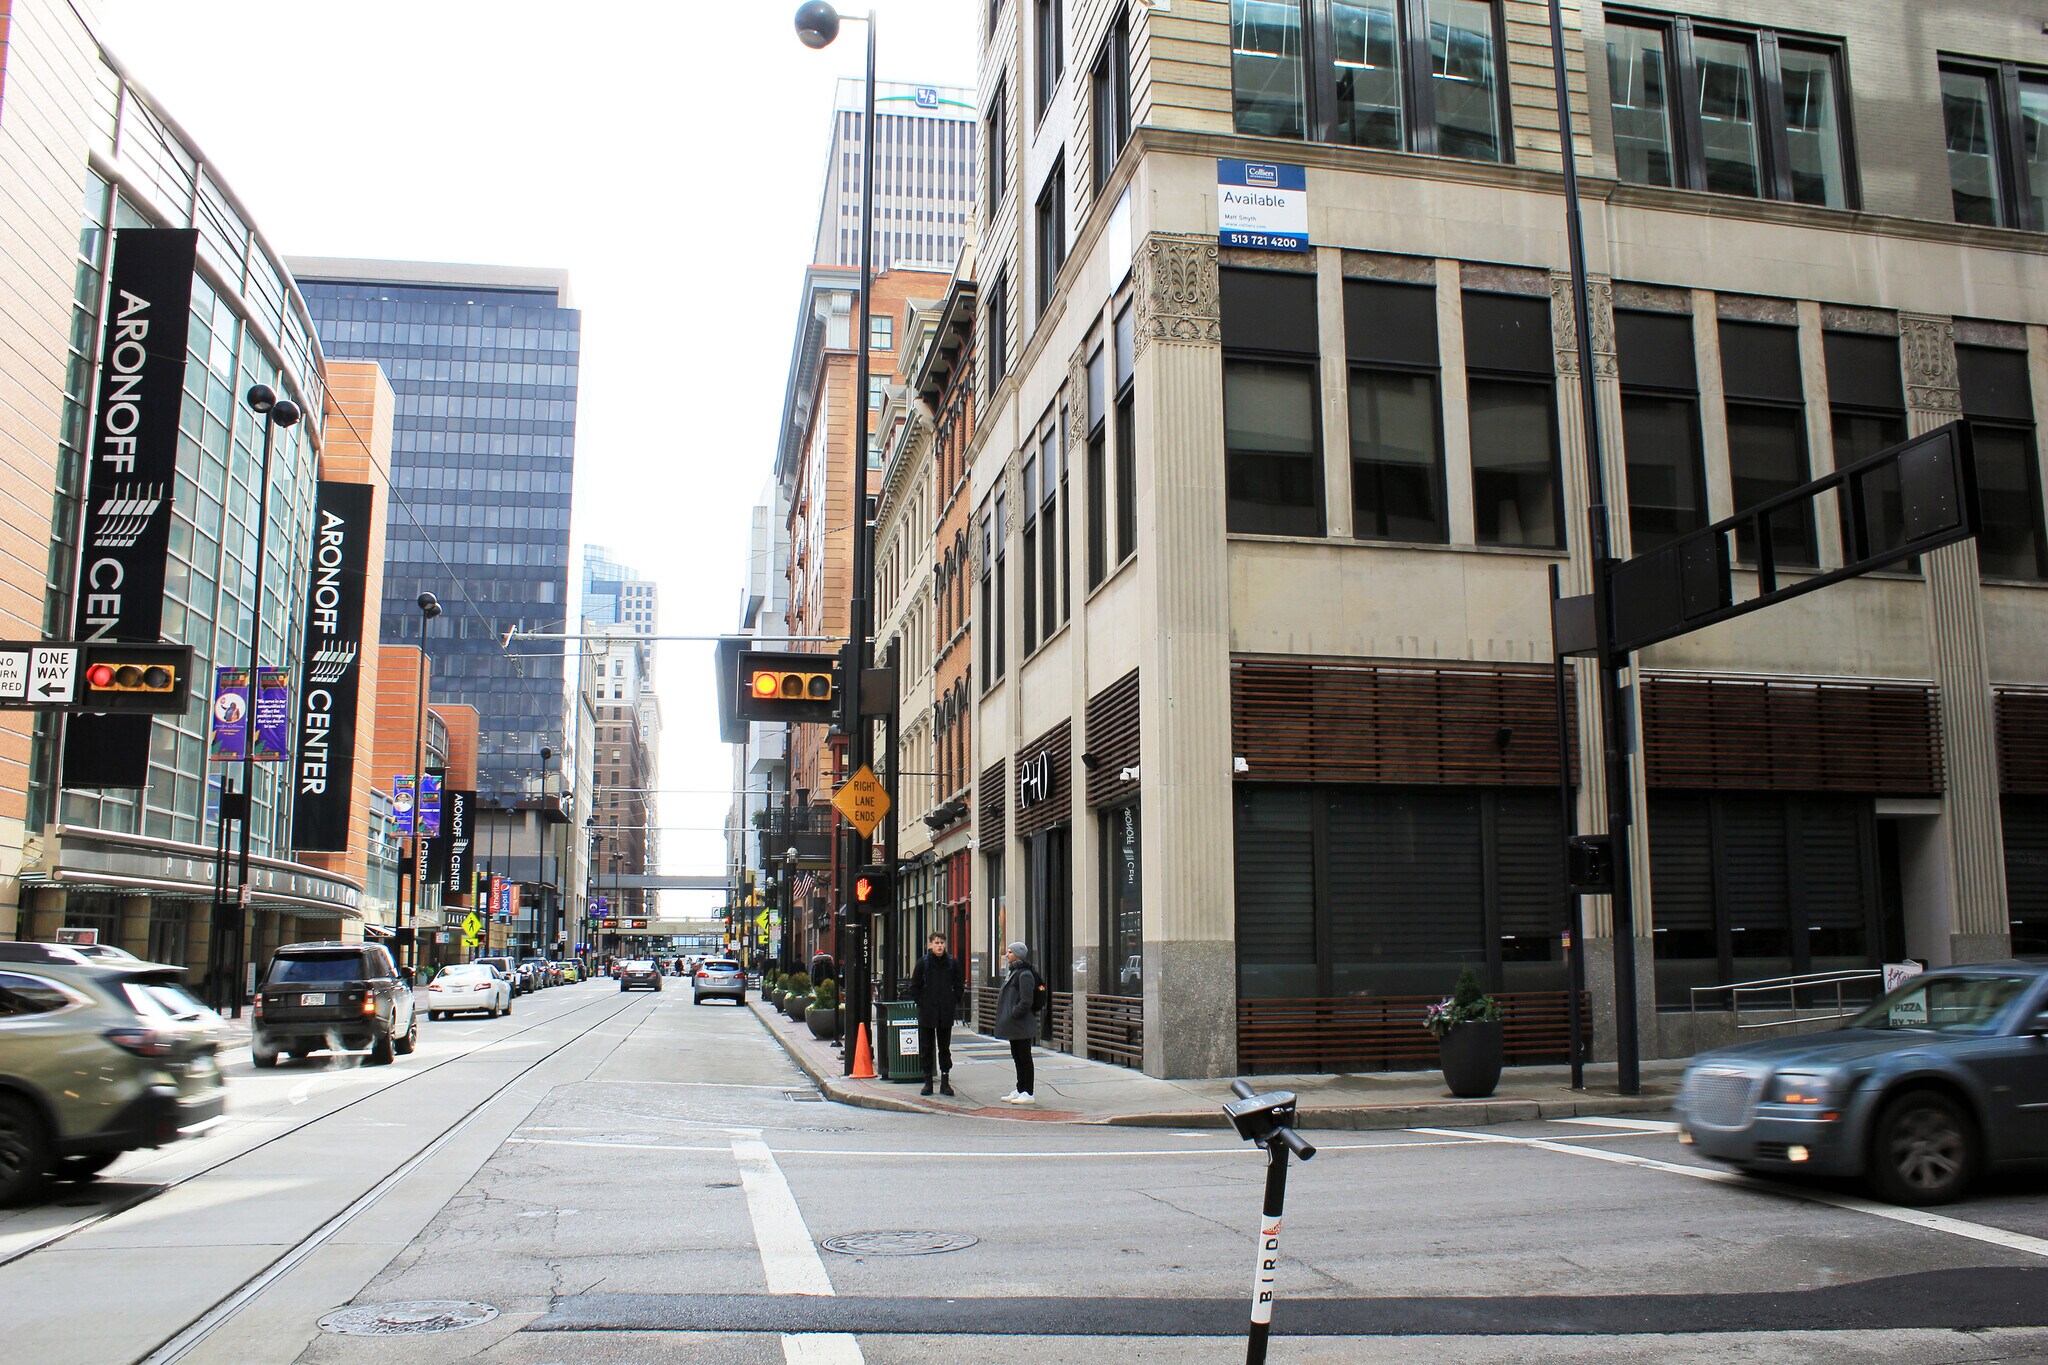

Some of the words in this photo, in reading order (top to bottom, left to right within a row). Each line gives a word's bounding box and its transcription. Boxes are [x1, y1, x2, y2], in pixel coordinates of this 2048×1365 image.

[1249, 167, 1274, 176] Colliers
[1224, 191, 1285, 208] Available
[1239, 214, 1257, 222] Smyth
[1231, 234, 1248, 244] 513
[1251, 235, 1268, 245] 721
[1270, 238, 1297, 248] 4200
[102, 289, 151, 474] ARONOFF
[313, 509, 345, 635] ARONOFF
[85, 557, 124, 644] CEN
[39, 652, 69, 665] ONE
[37, 667, 69, 679] WAY
[1, 682, 22, 691] RED
[301, 689, 332, 795] CENTER
[853, 780, 876, 793] RIGHT
[854, 795, 875, 807] LANE
[452, 793, 463, 837] ARONOFF
[854, 811, 875, 822] ENDS
[450, 856, 461, 891] CENTER
[490, 879, 500, 910] Ameritas
[1894, 1002, 1922, 1013] PIZZA
[1258, 1237, 1279, 1304] BIRD
